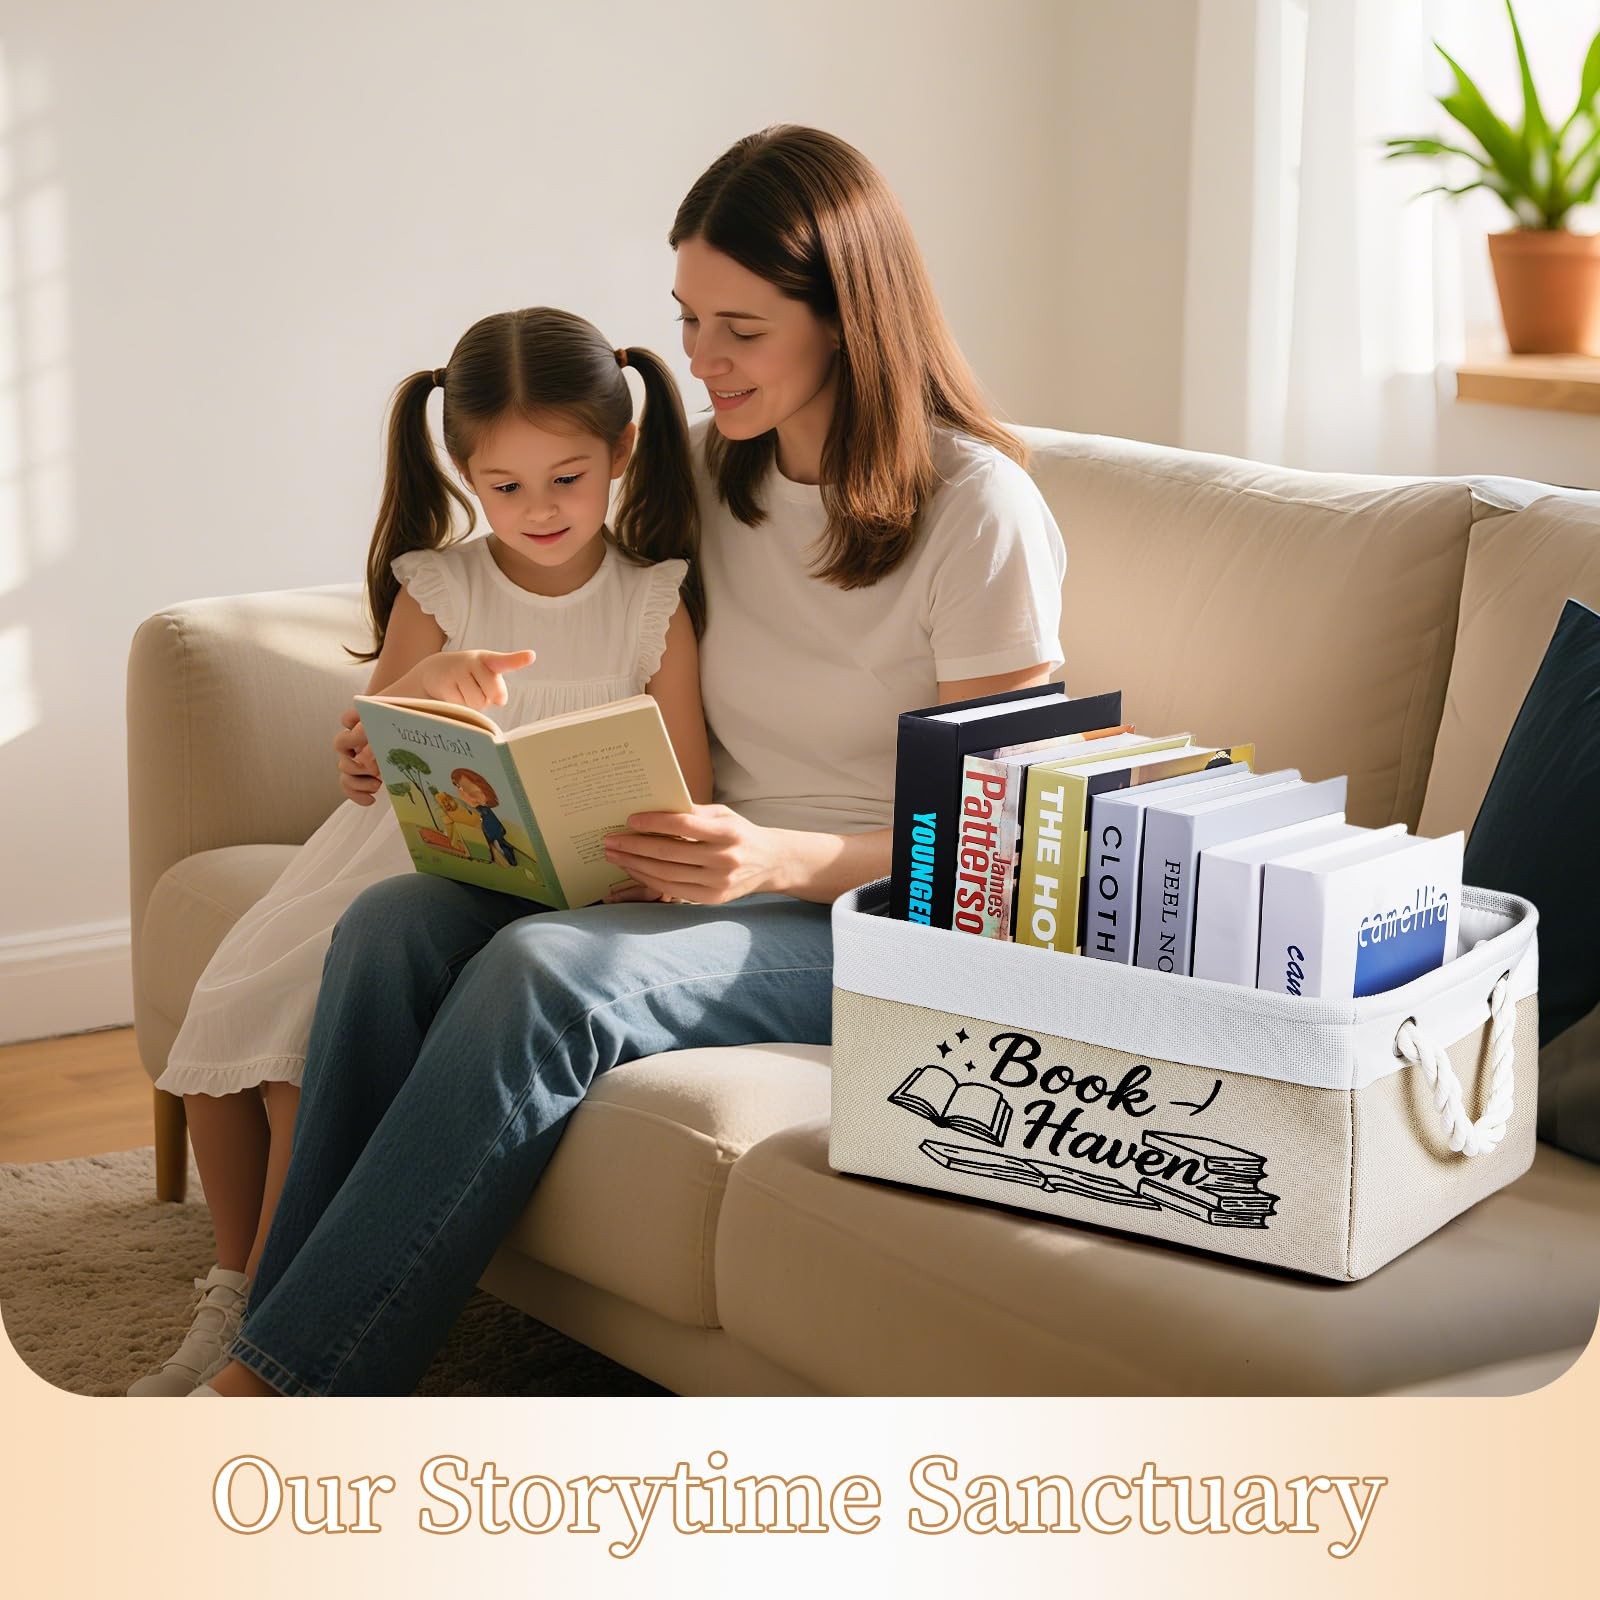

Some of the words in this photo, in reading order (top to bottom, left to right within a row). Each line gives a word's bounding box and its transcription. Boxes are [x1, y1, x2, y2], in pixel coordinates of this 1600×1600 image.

[955, 769, 1006, 935] Patterso
[1035, 785, 1065, 865] THE
[987, 850, 1012, 919] James
[1096, 825, 1123, 961] CLOTH
[1162, 858, 1181, 923] FEEL
[1357, 884, 1449, 948] camellia
[1157, 931, 1176, 973] NO
[989, 1032, 1156, 1118] Book
[1022, 1099, 1210, 1187] Haven
